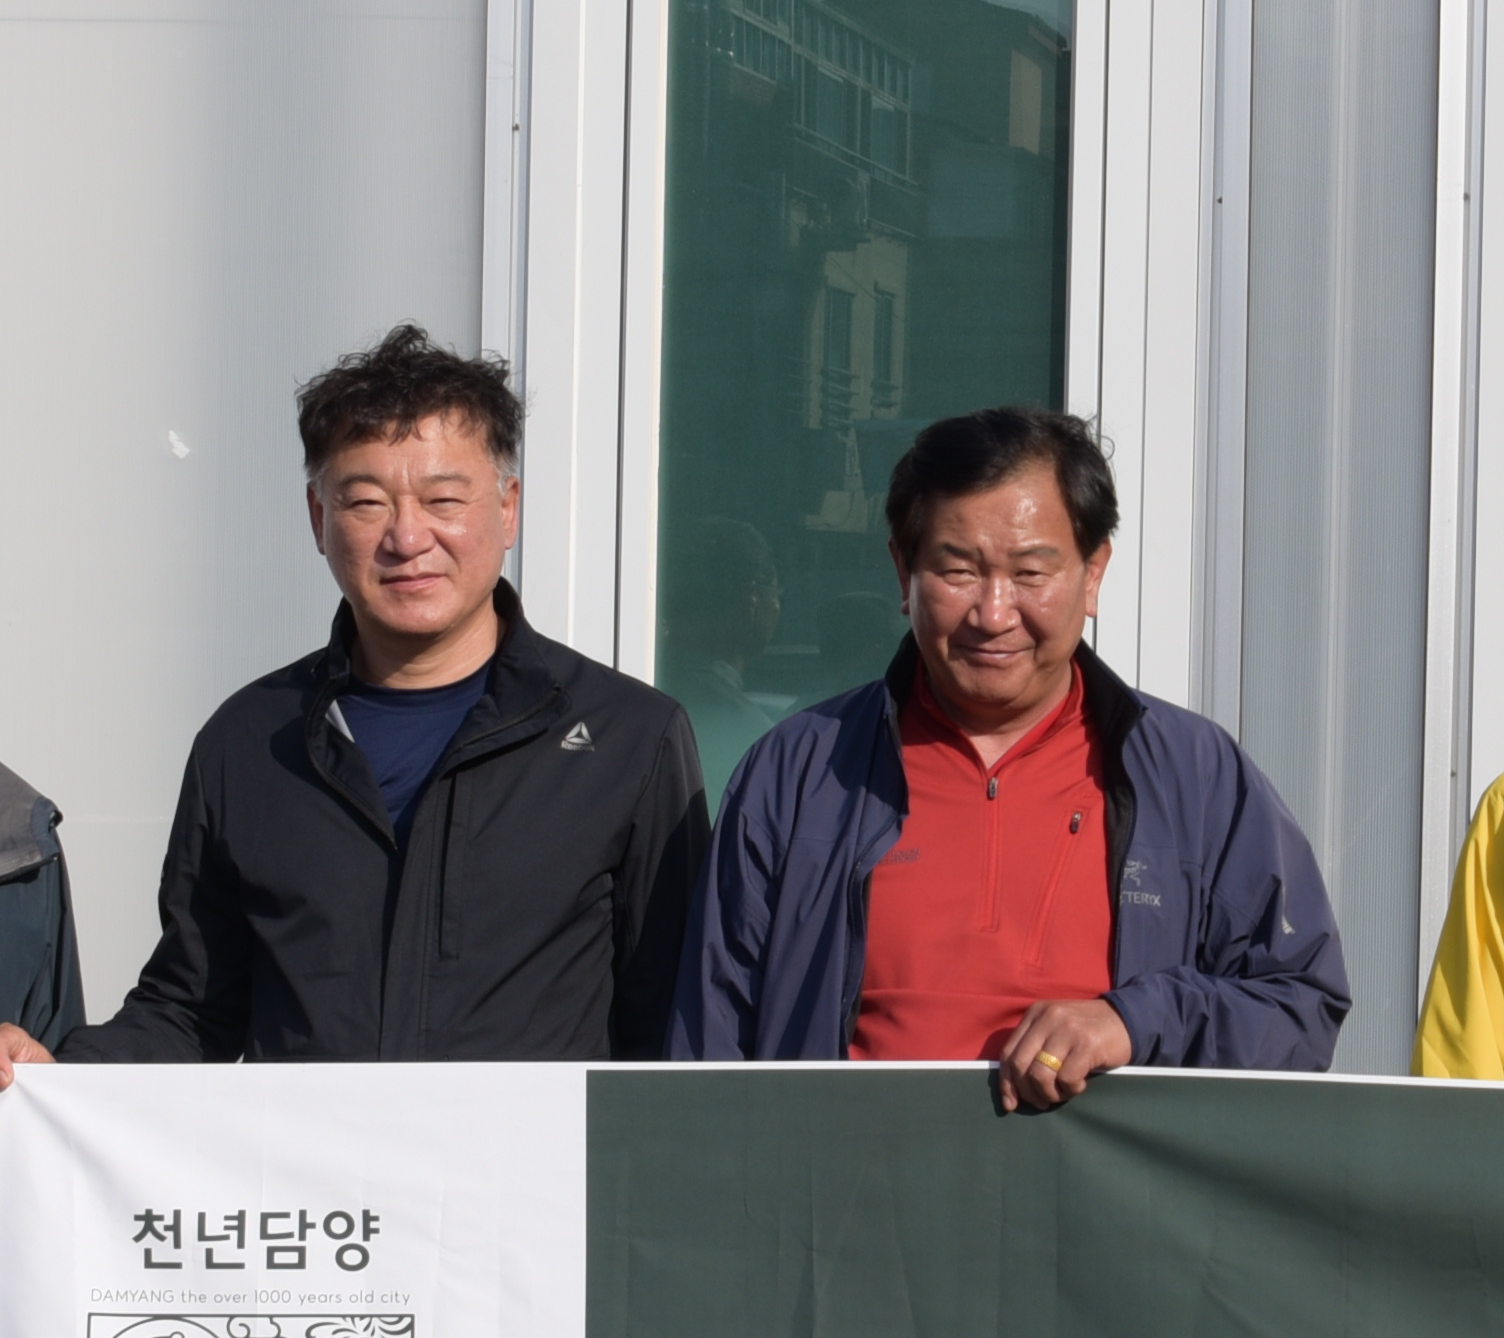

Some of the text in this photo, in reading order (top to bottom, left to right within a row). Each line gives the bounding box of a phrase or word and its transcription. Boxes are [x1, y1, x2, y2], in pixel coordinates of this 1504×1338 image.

[132, 1208, 380, 1272] 천년담양
[90, 1288, 411, 1307] DAMYANG the over 1000 years old city
